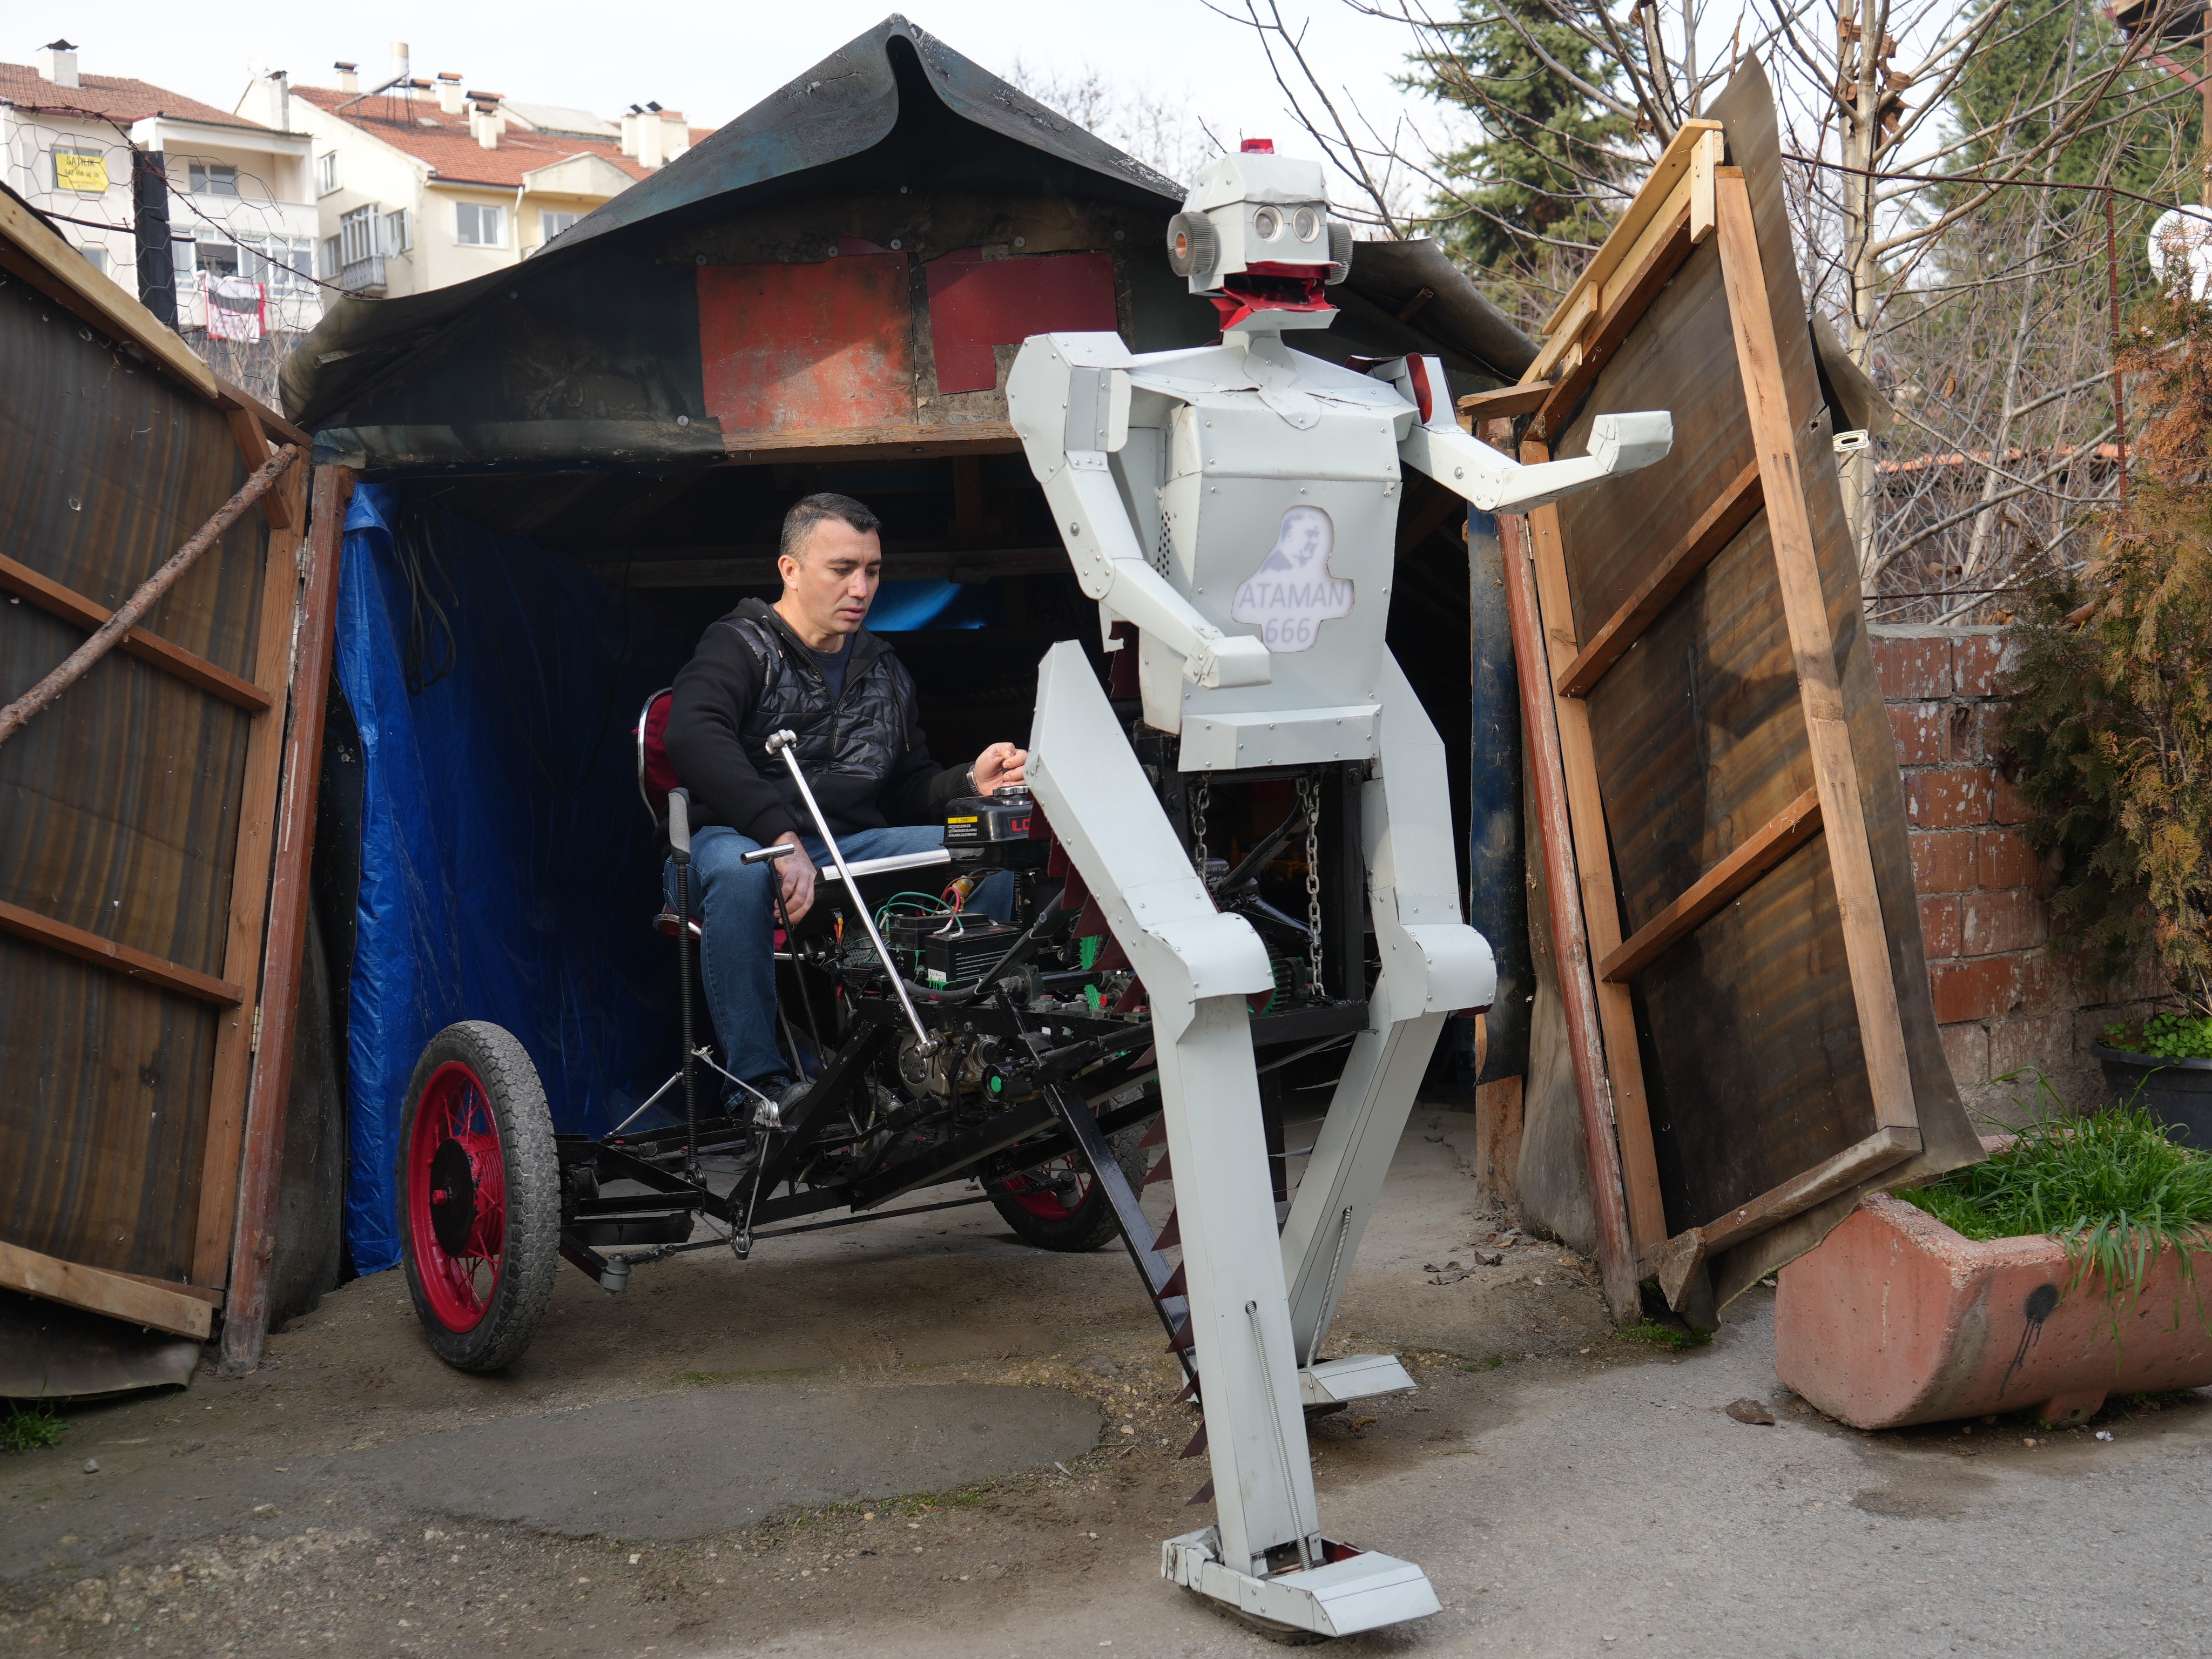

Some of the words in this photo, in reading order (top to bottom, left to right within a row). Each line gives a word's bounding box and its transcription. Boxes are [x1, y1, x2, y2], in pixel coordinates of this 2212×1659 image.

[66, 156, 95, 167] SATILIK
[1239, 582, 1345, 609] ATAMAN
[1265, 618, 1311, 643] 666
